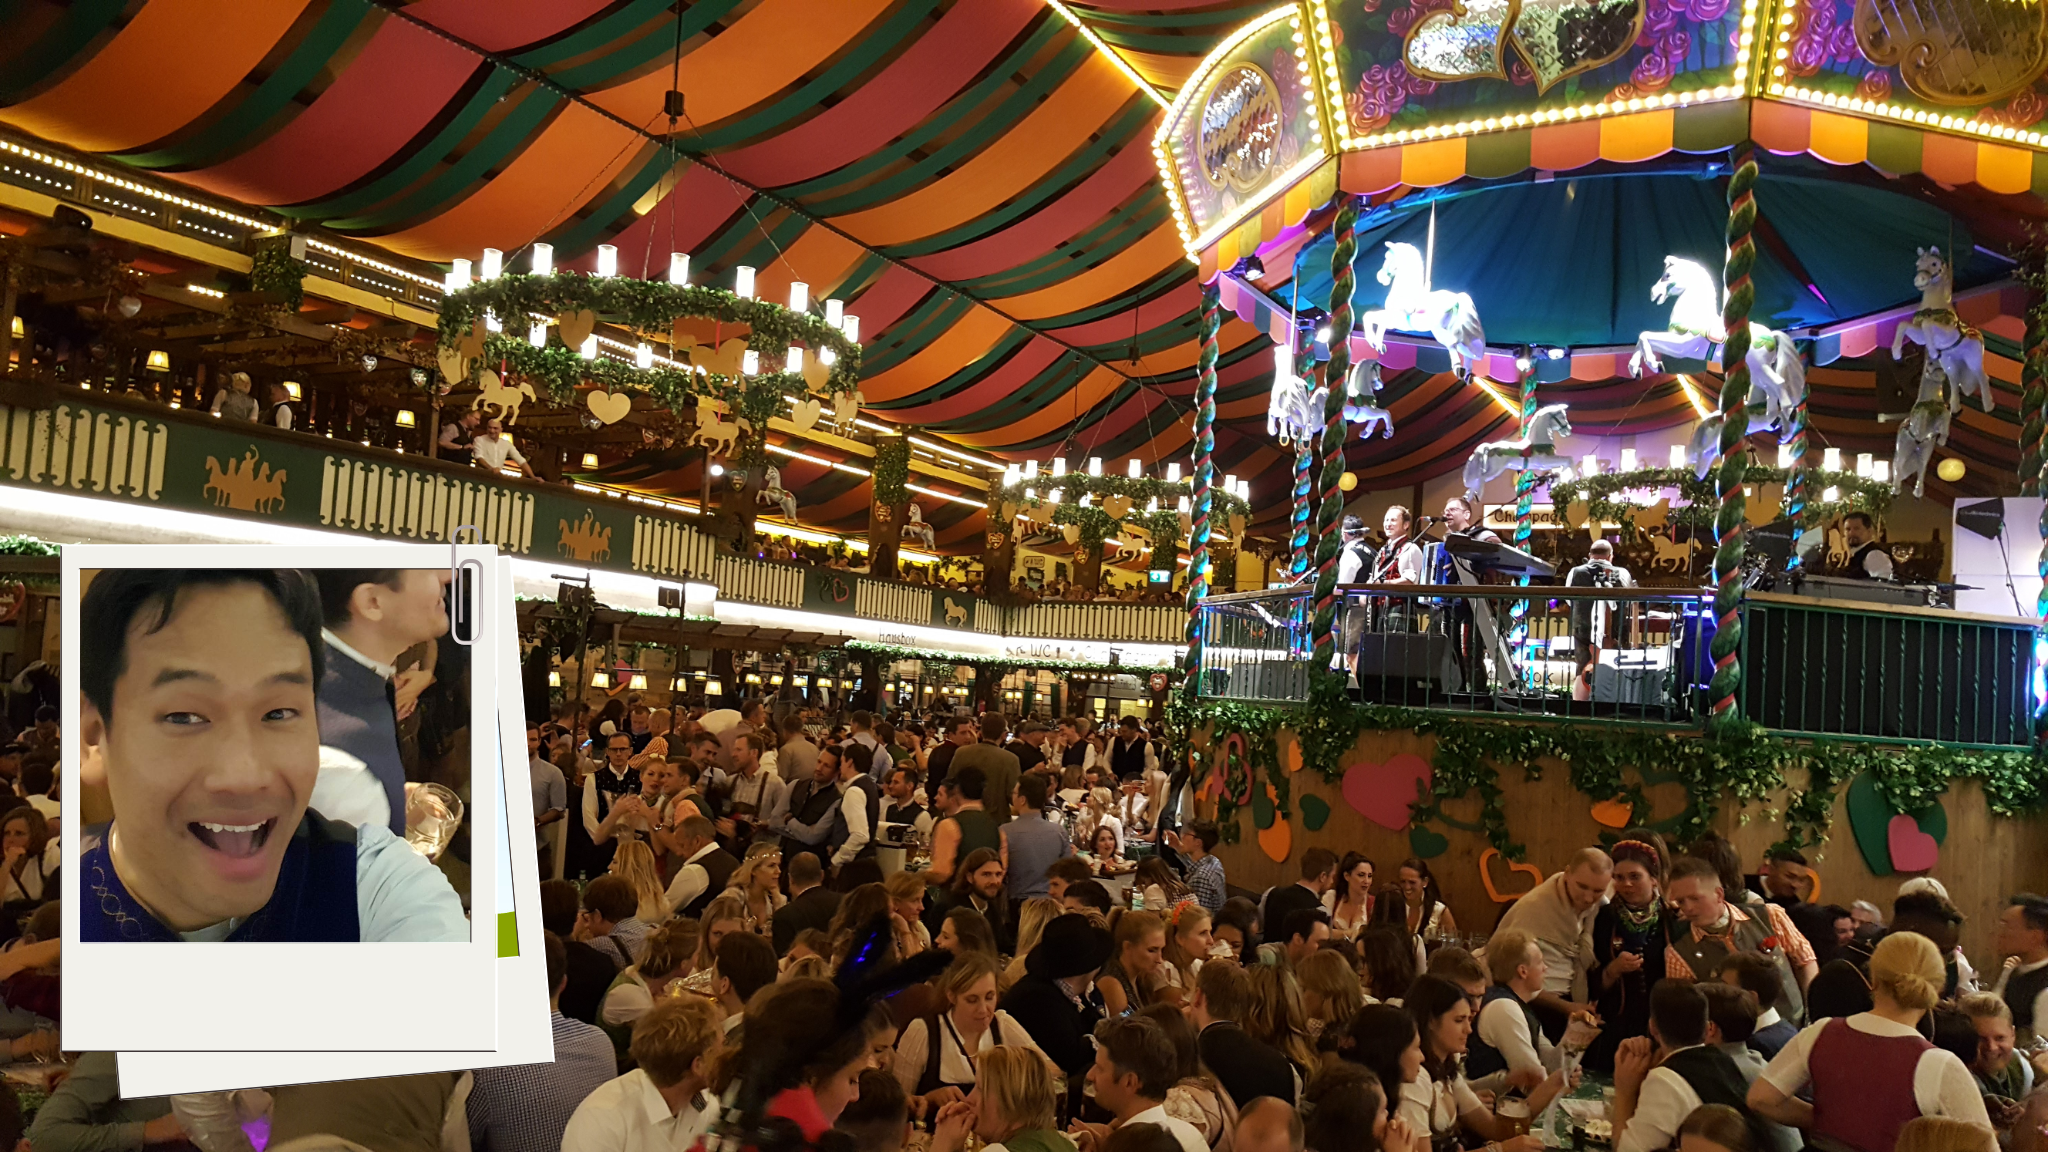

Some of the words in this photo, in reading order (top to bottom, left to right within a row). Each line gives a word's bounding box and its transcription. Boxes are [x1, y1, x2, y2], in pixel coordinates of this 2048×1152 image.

[566, 586, 575, 603] K
[666, 590, 673, 606] L
[878, 628, 917, 646] Hausbox
[1030, 643, 1051, 658] WC
